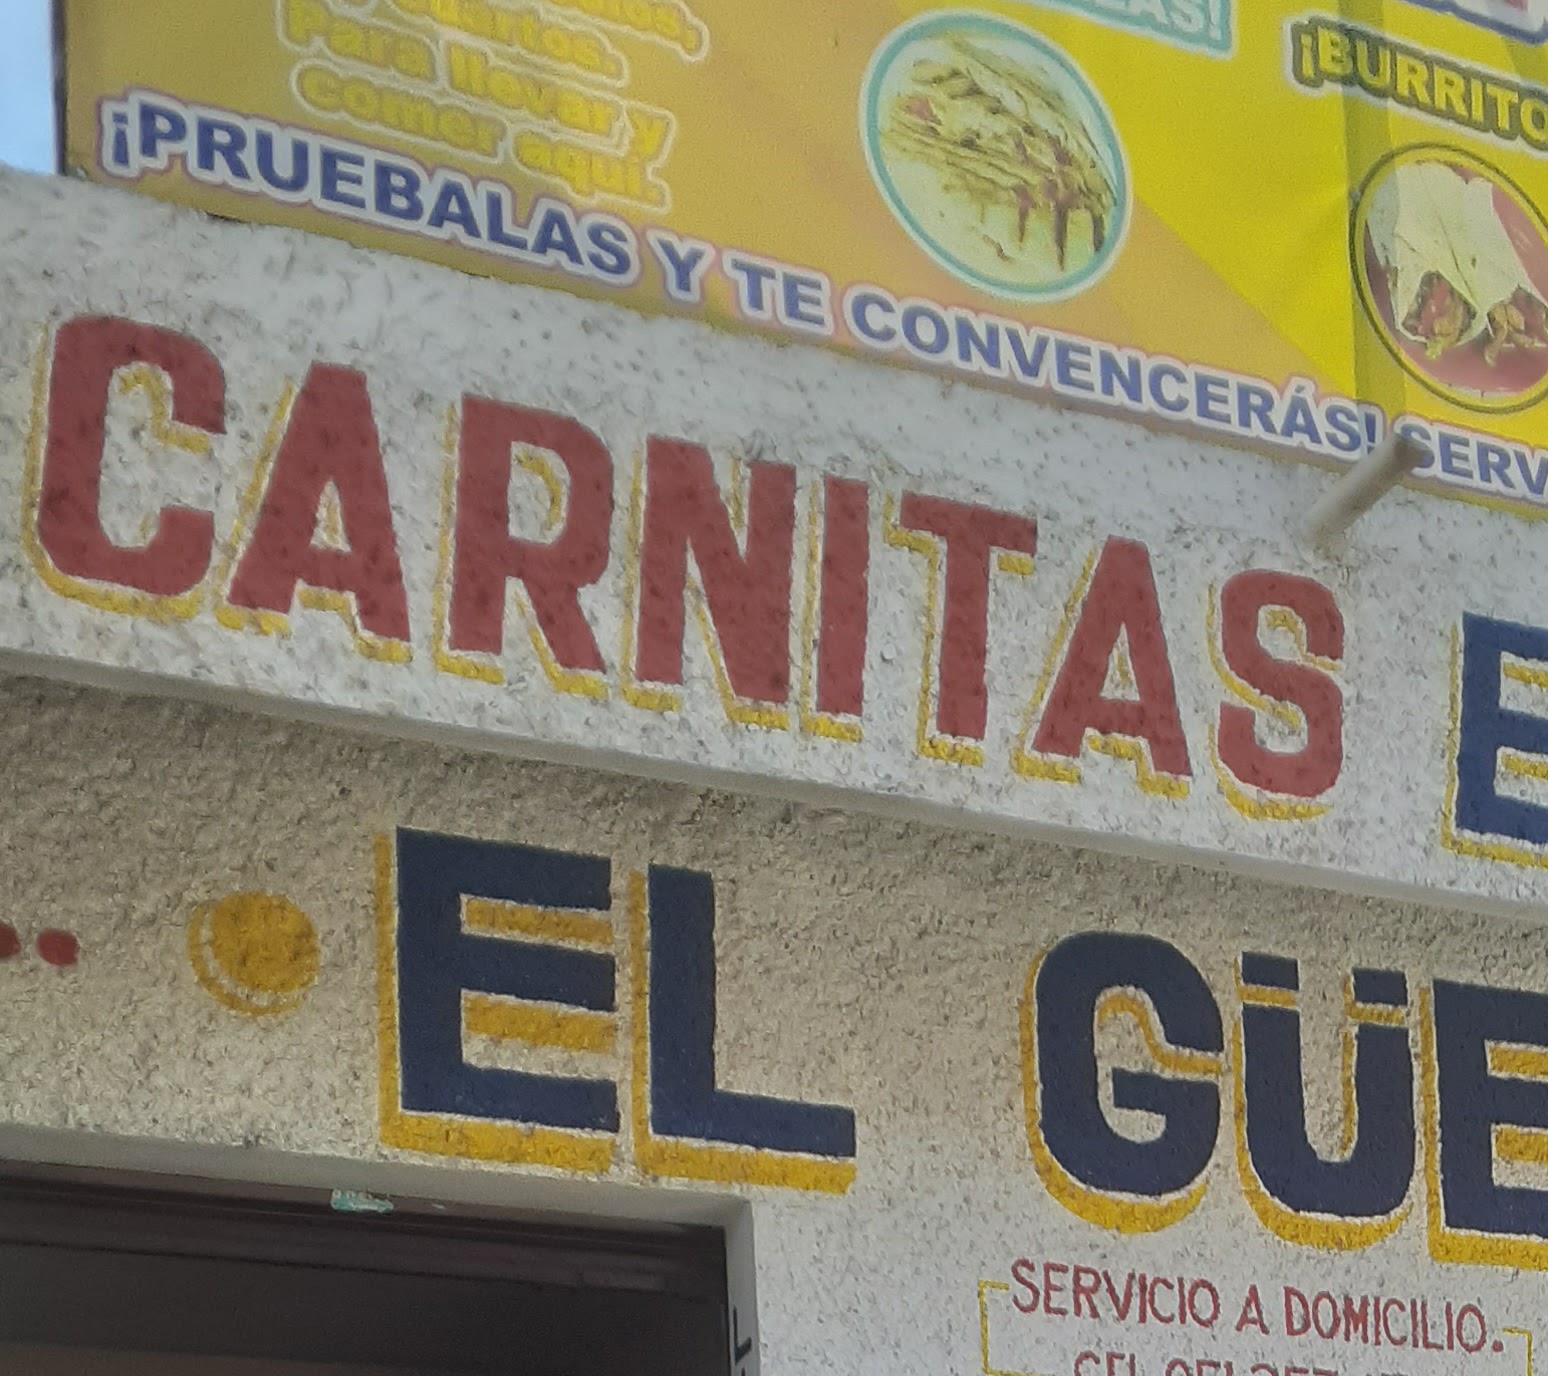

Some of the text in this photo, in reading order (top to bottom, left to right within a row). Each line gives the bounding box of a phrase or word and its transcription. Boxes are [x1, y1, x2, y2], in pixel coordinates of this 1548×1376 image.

[111, 103, 631, 276] ¡PRUEBALAS
[659, 239, 704, 293] Y
[733, 260, 825, 327] TE
[851, 293, 1378, 452] CONVENCERÁS!
[30, 313, 1345, 805] CARNITAS
[385, 825, 857, 1175] EL
[1011, 1259, 1504, 1353] SERVICIO A DOMICILIO.
